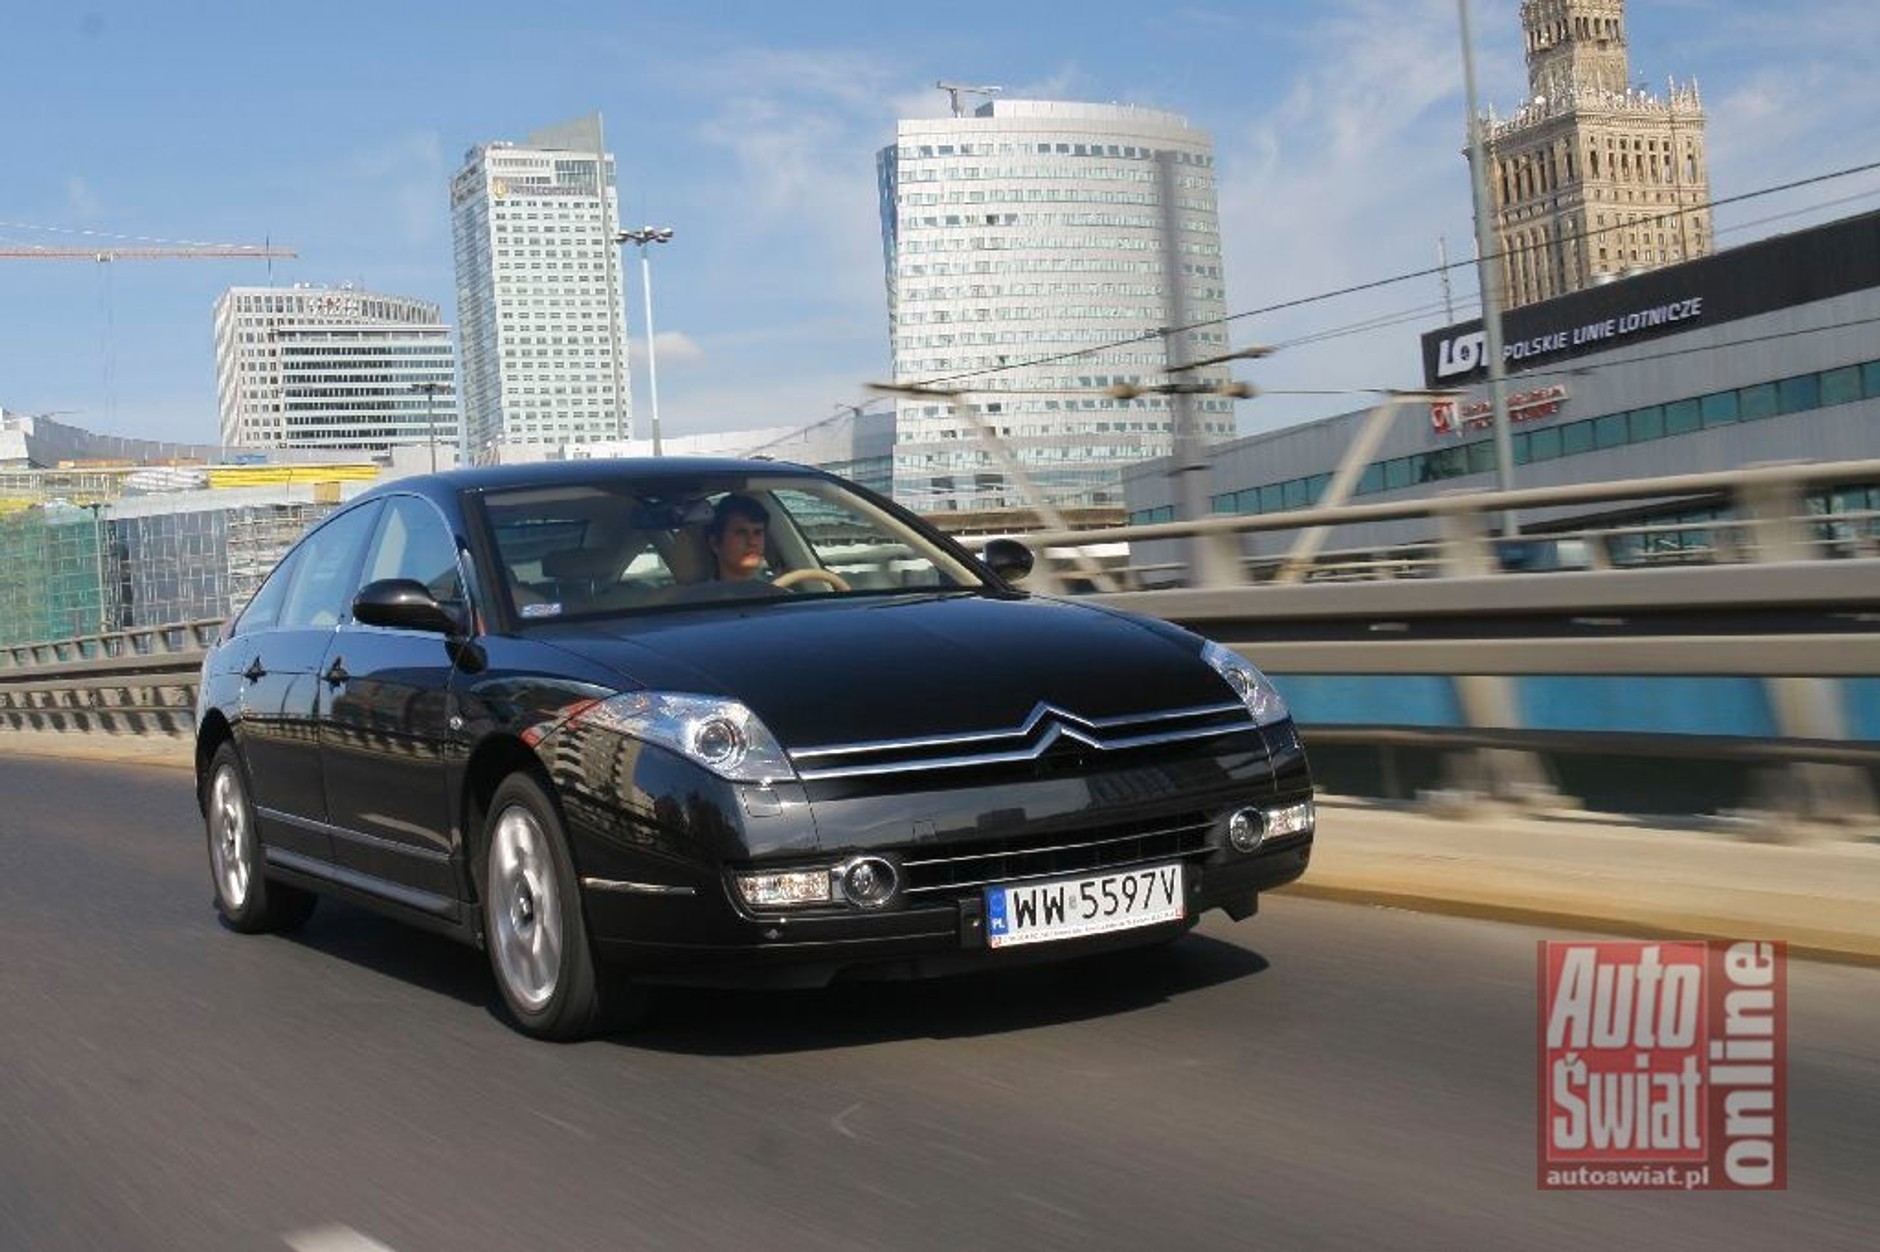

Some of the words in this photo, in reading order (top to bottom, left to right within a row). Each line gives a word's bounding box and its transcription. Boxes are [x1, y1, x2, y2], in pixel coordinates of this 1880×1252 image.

[1503, 331, 1569, 360] POLSKIE
[1572, 319, 1616, 345] LINIE
[1618, 297, 1703, 334] LOTNICZE
[992, 918, 1005, 930] PL
[1013, 886, 1064, 929] WW
[1079, 868, 1176, 919] 5597V
